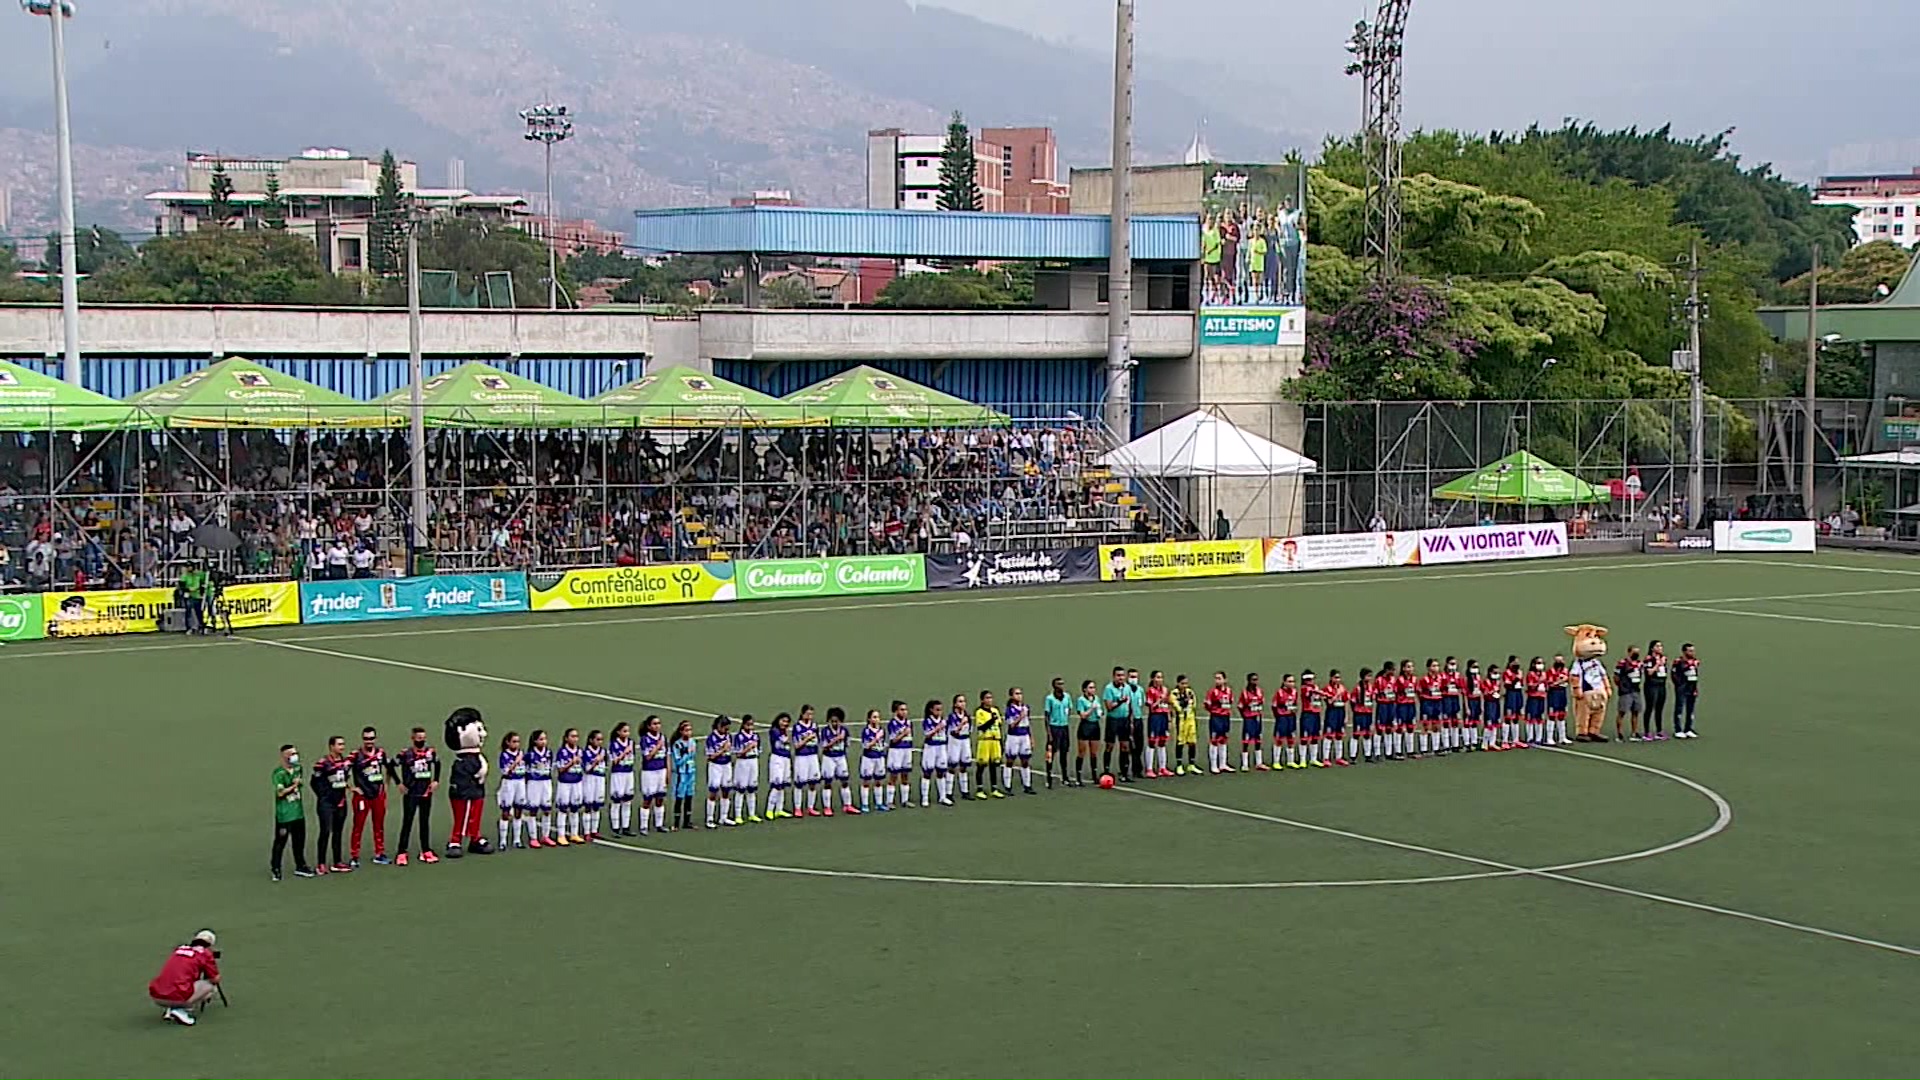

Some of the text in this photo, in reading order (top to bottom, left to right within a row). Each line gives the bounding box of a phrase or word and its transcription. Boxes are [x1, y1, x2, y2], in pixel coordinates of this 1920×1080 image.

[1205, 318, 1275, 331] ATLETISMO
[994, 551, 1037, 570] Festival
[1166, 553, 1195, 567] LIMPIO
[1197, 552, 1214, 566] POR
[1217, 551, 1245, 565] FAVOR!
[570, 572, 666, 594] Comfenalco
[749, 568, 823, 588] Colanta
[838, 564, 910, 584] Colanta
[311, 591, 364, 614] inder
[425, 587, 475, 609] inder
[587, 594, 655, 605] Antioquia
